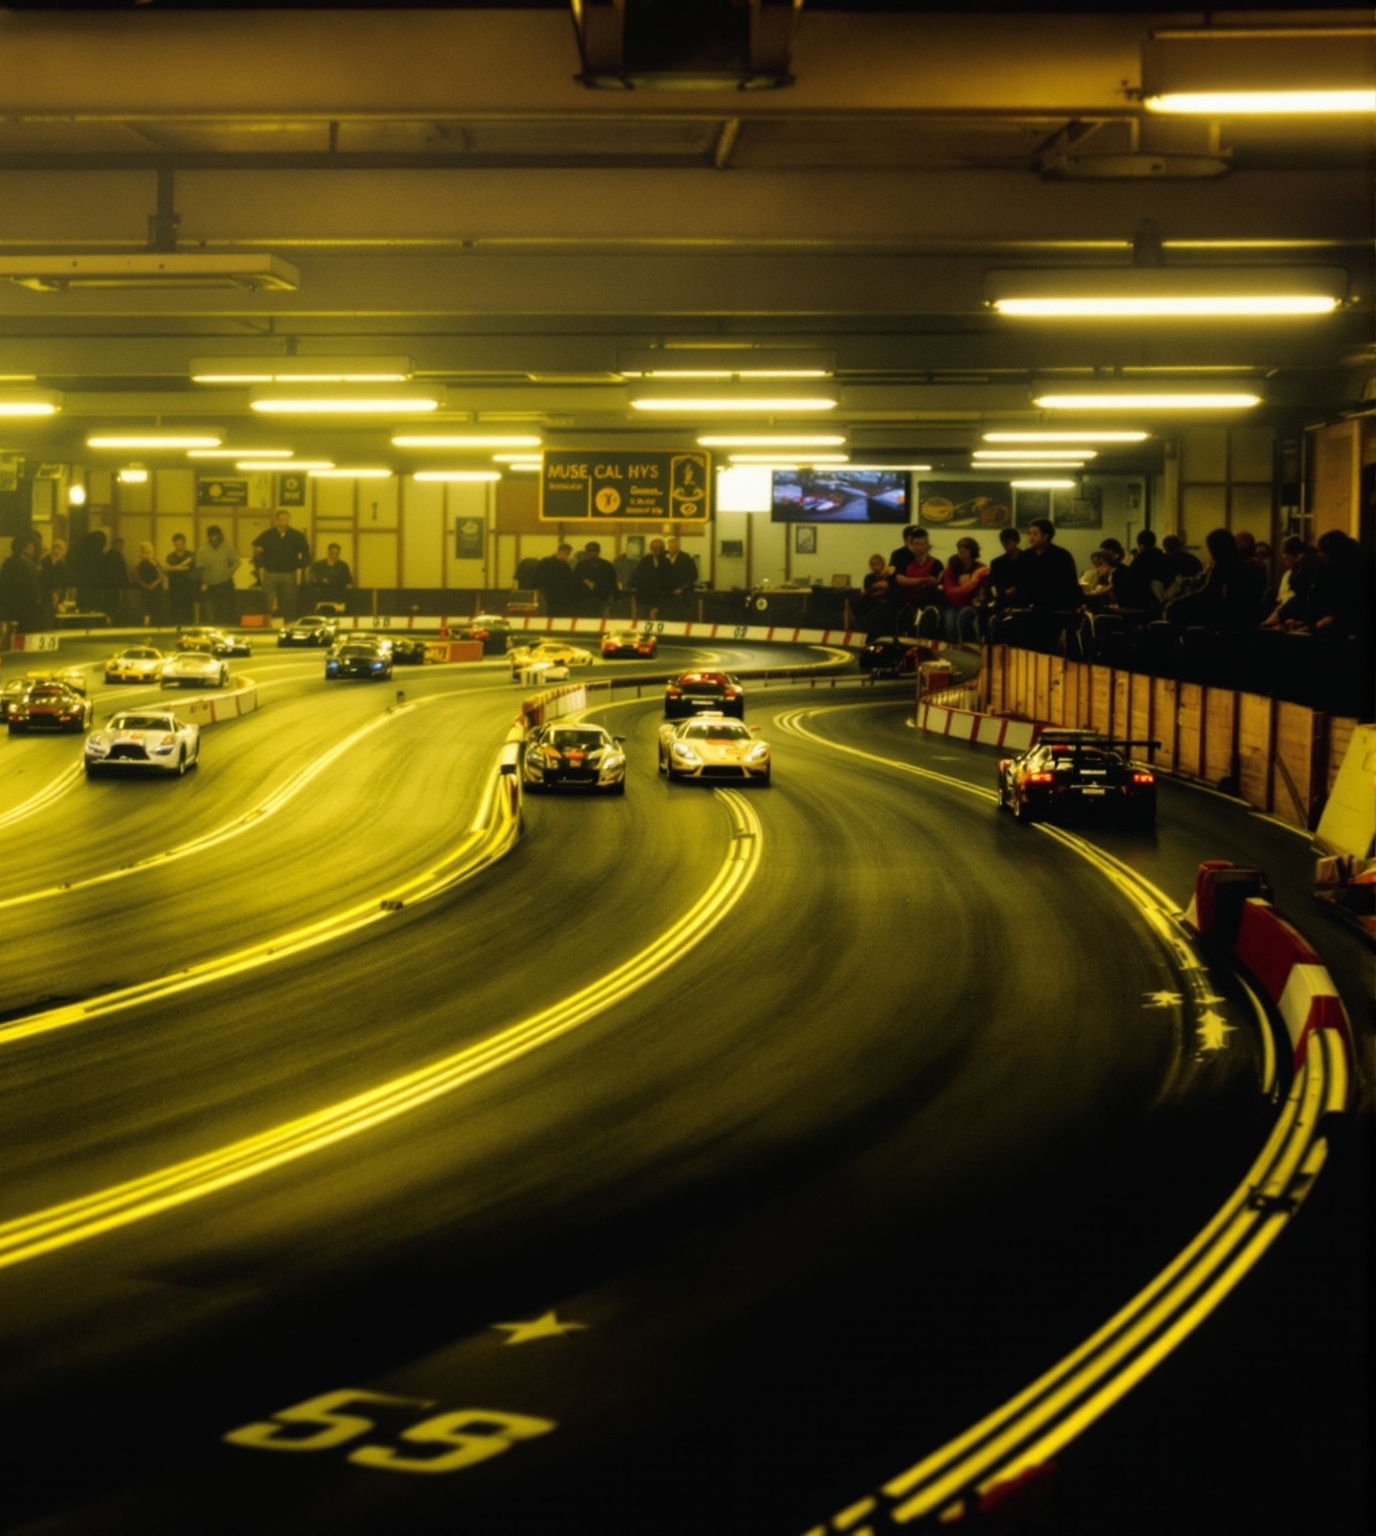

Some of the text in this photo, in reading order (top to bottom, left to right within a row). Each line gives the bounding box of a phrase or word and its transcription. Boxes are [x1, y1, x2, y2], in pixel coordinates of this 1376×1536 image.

[548, 464, 659, 479] MUSE CAL HYS
